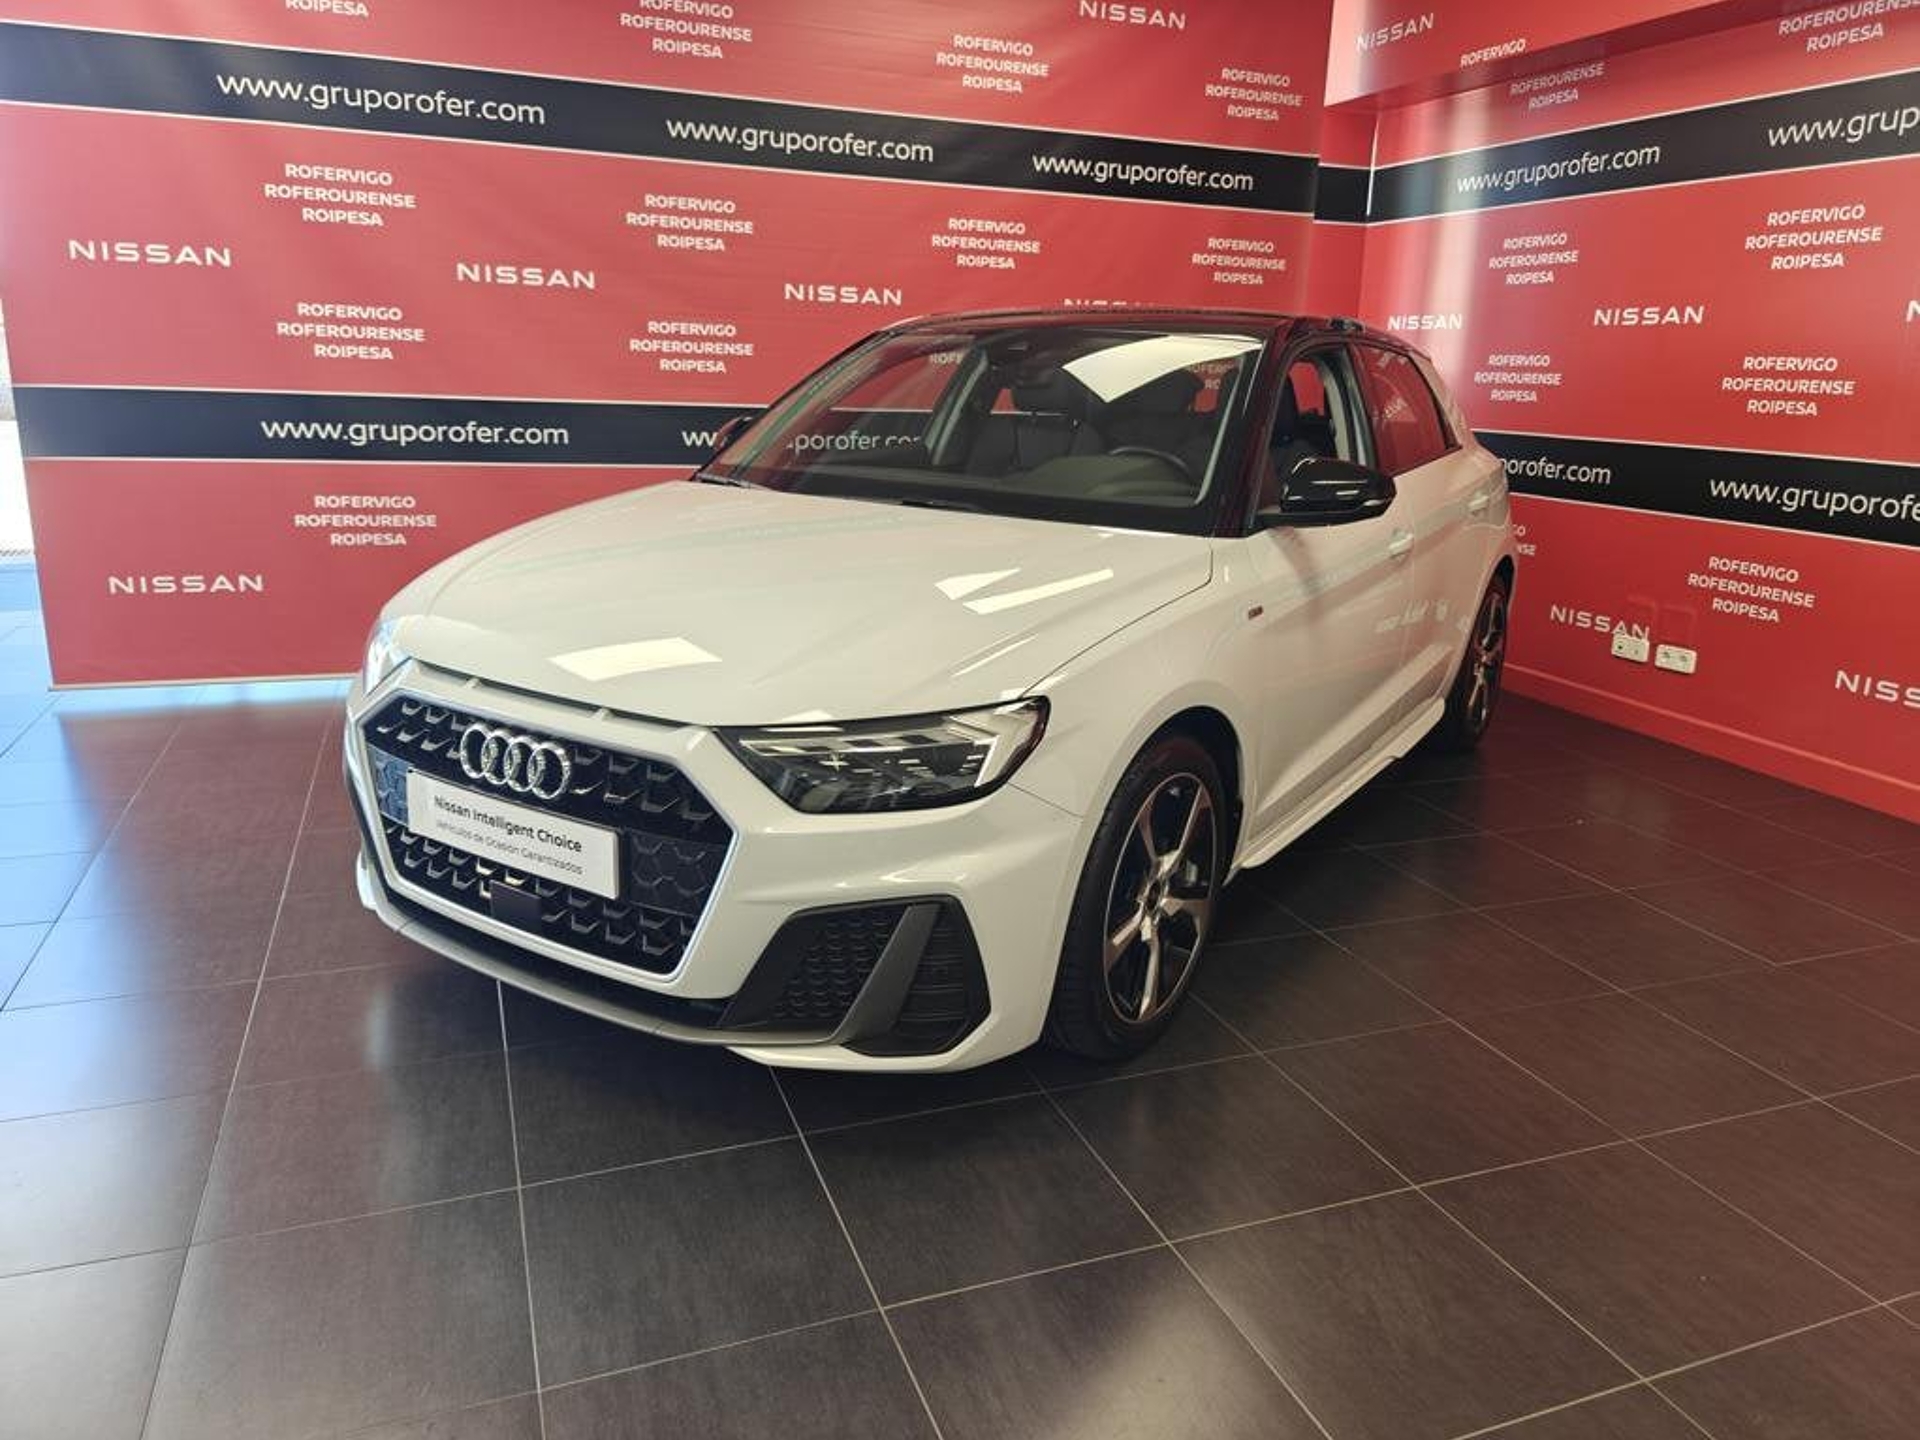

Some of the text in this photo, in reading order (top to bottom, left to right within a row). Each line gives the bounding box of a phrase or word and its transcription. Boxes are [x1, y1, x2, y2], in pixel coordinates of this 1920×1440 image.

[285, 0, 369, 17] ROIPESA
[640, 0, 734, 19] ROFERVIGO
[1079, 0, 1186, 30] NISSAN
[1779, 0, 1920, 35] ROFEROURENS
[620, 13, 753, 42] ROFEROURENSE
[1355, 12, 1434, 51] NISSAN
[1806, 22, 1884, 52] ROIPESA
[652, 37, 723, 59] ROIPESA
[953, 34, 1034, 57] ROFERVIGO
[1460, 38, 1527, 68] ROFERVIGO
[936, 52, 1049, 78] ROFEROURENSE
[961, 75, 1023, 94] ROIPESA
[1221, 67, 1291, 87] ROFERVIGO
[1510, 62, 1605, 97] ROFEROURENSE
[216, 74, 545, 125] www.gruporofer.com
[1205, 84, 1303, 107] ROFEROURENSE
[1528, 88, 1579, 110] ROIPESA
[1227, 104, 1279, 121] ROIPESA
[666, 119, 933, 162] www.gruporofer.com
[284, 162, 393, 187] ROFERVIGO
[1032, 155, 1254, 191] www.gruporofer.com
[1457, 144, 1661, 194] www.gruporofer.com
[264, 183, 417, 209] ROFEROURENSE
[644, 193, 736, 214] ROFERVIGO
[302, 206, 384, 228] ROIPESA
[626, 212, 754, 235] ROFEROURENSE
[948, 216, 1026, 236] ROFERVIGO
[1767, 204, 1865, 227] ROFERVIGO
[657, 232, 726, 252] ROIPESA
[931, 233, 1040, 256] ROFEROURENSE
[1207, 236, 1274, 255] ROFERVIGO
[1502, 233, 1568, 251] ROFERVIGO
[1744, 227, 1882, 250] ROFEROURENSE
[68, 238, 232, 268] NISSAN
[956, 253, 1016, 271] ROIPESA
[1191, 253, 1286, 272] ROFEROURENSE
[1488, 250, 1579, 270] ROFEROURENSE
[1771, 252, 1845, 270] ROIPESA
[456, 262, 596, 290] NISSAN
[1213, 270, 1264, 287] ROIPESA
[1505, 270, 1555, 285] ROIPESA
[784, 282, 902, 306] NISSAN
[296, 301, 403, 322] ROFERVIGO
[1388, 313, 1463, 330] NISSAN
[1593, 306, 1704, 326] NISSAN
[276, 321, 426, 343] ROFEROURENSE
[647, 320, 737, 339] ROFERVIGO
[313, 343, 394, 361] ROIPESA
[629, 338, 754, 357] ROFEROURENSE
[659, 358, 727, 374] ROIPESA
[1488, 354, 1551, 367] ROFERVIGO
[1743, 356, 1838, 372] ROFERVIGO
[1473, 371, 1562, 386] ROFEROURENSE
[1721, 377, 1854, 396] ROFEROURENSE
[1490, 389, 1537, 402] ROIPESA
[1746, 399, 1818, 416] ROIPESA
[261, 418, 569, 447] www.gruporofer.com
[313, 495, 416, 509] ROFERVIGO
[294, 514, 437, 530] ROFEROURENSE
[330, 532, 407, 546] ROIPESA
[1708, 556, 1799, 584] ROFERVIGO
[108, 575, 264, 594] NISSAN
[1687, 573, 1815, 608] ROFEROURENSE
[1712, 597, 1779, 623] ROIPESA
[1550, 604, 1650, 640] NISSAN
[434, 795, 582, 852] Nissan Intelligent Choice
